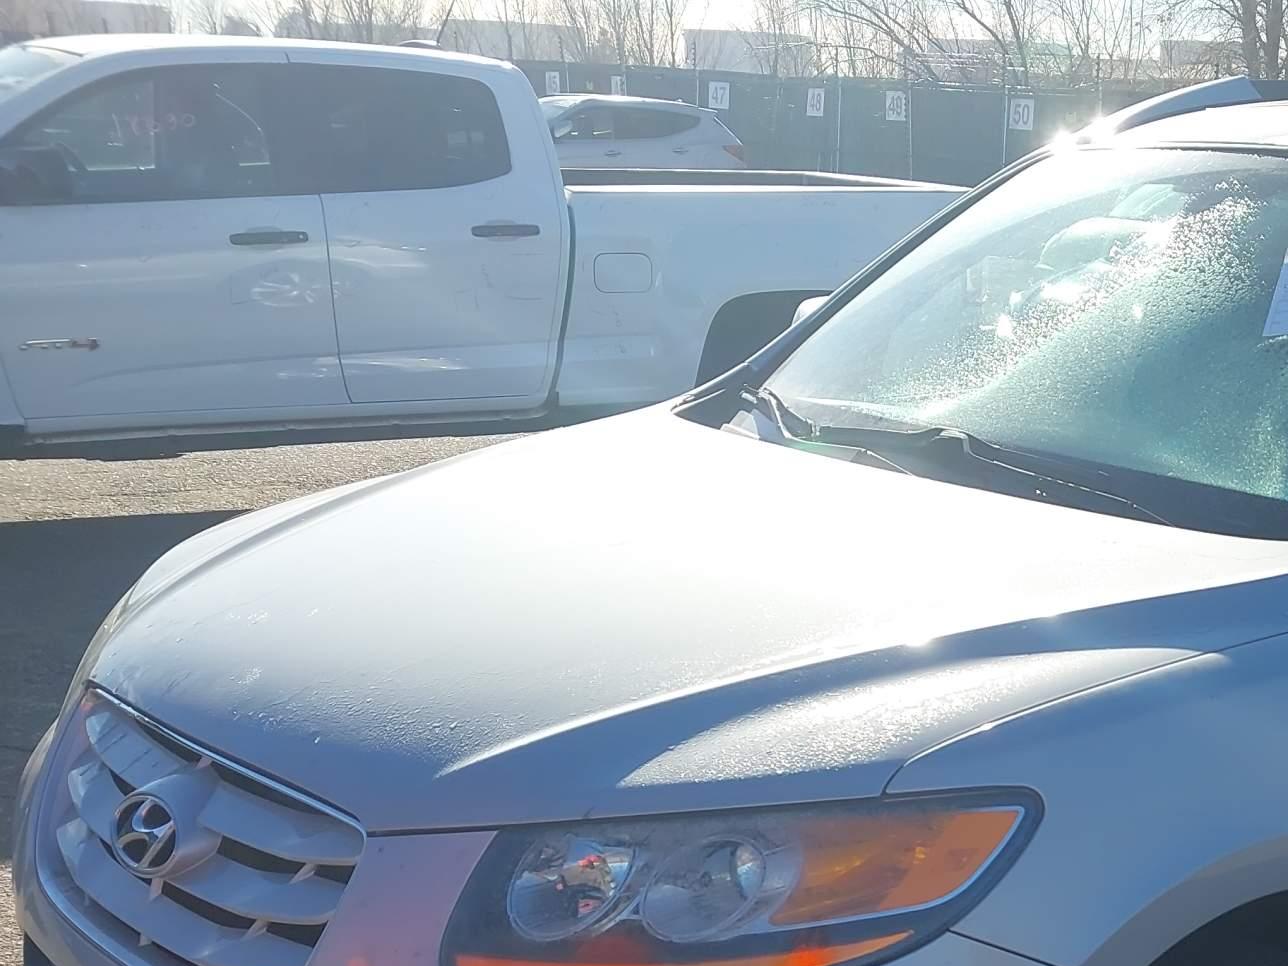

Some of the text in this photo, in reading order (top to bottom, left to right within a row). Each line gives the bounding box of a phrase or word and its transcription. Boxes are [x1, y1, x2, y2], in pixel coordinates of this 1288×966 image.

[711, 86, 726, 105] 47
[808, 91, 823, 112] 48
[887, 95, 902, 116] 49
[1013, 103, 1030, 125] 50
